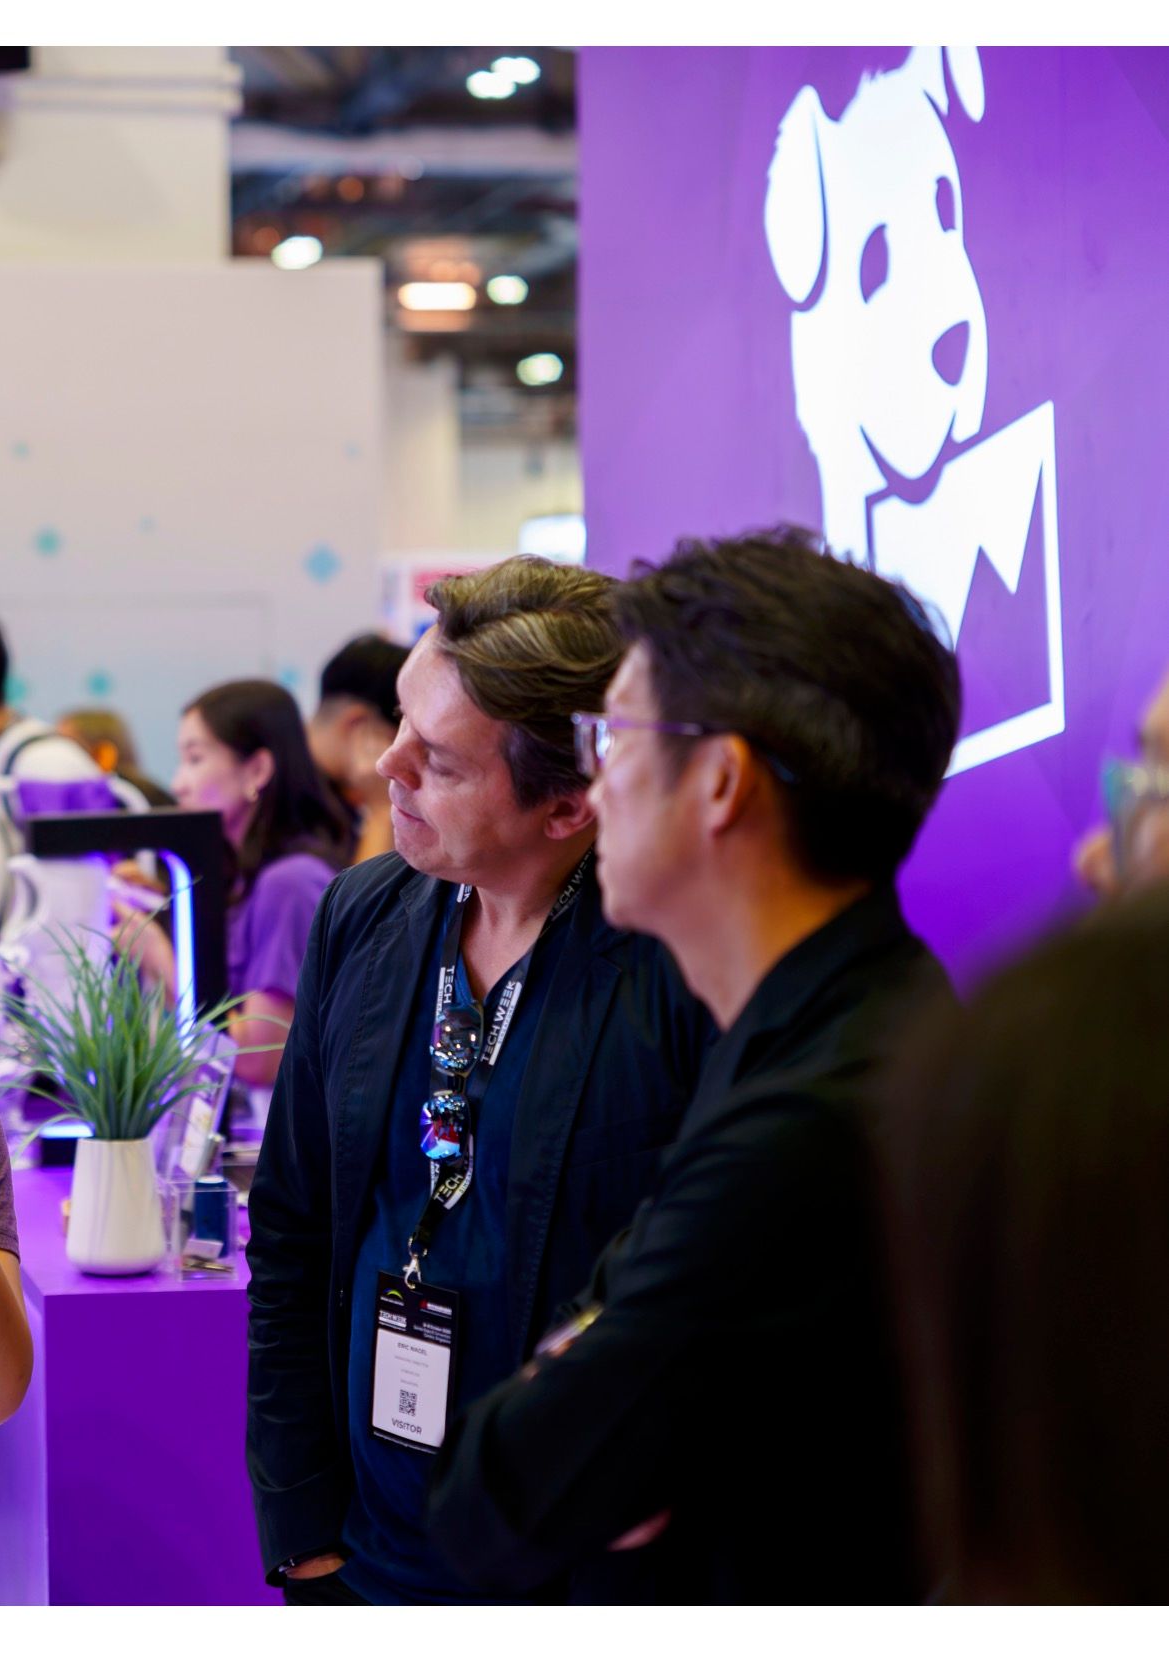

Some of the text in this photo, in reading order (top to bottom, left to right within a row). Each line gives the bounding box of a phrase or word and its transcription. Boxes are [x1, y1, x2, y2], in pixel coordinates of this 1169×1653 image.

[443, 965, 456, 1004] TECH
[480, 980, 516, 1062] TECH WEEK
[434, 1173, 464, 1203] TECH
[392, 1418, 423, 1436] VISITOR
